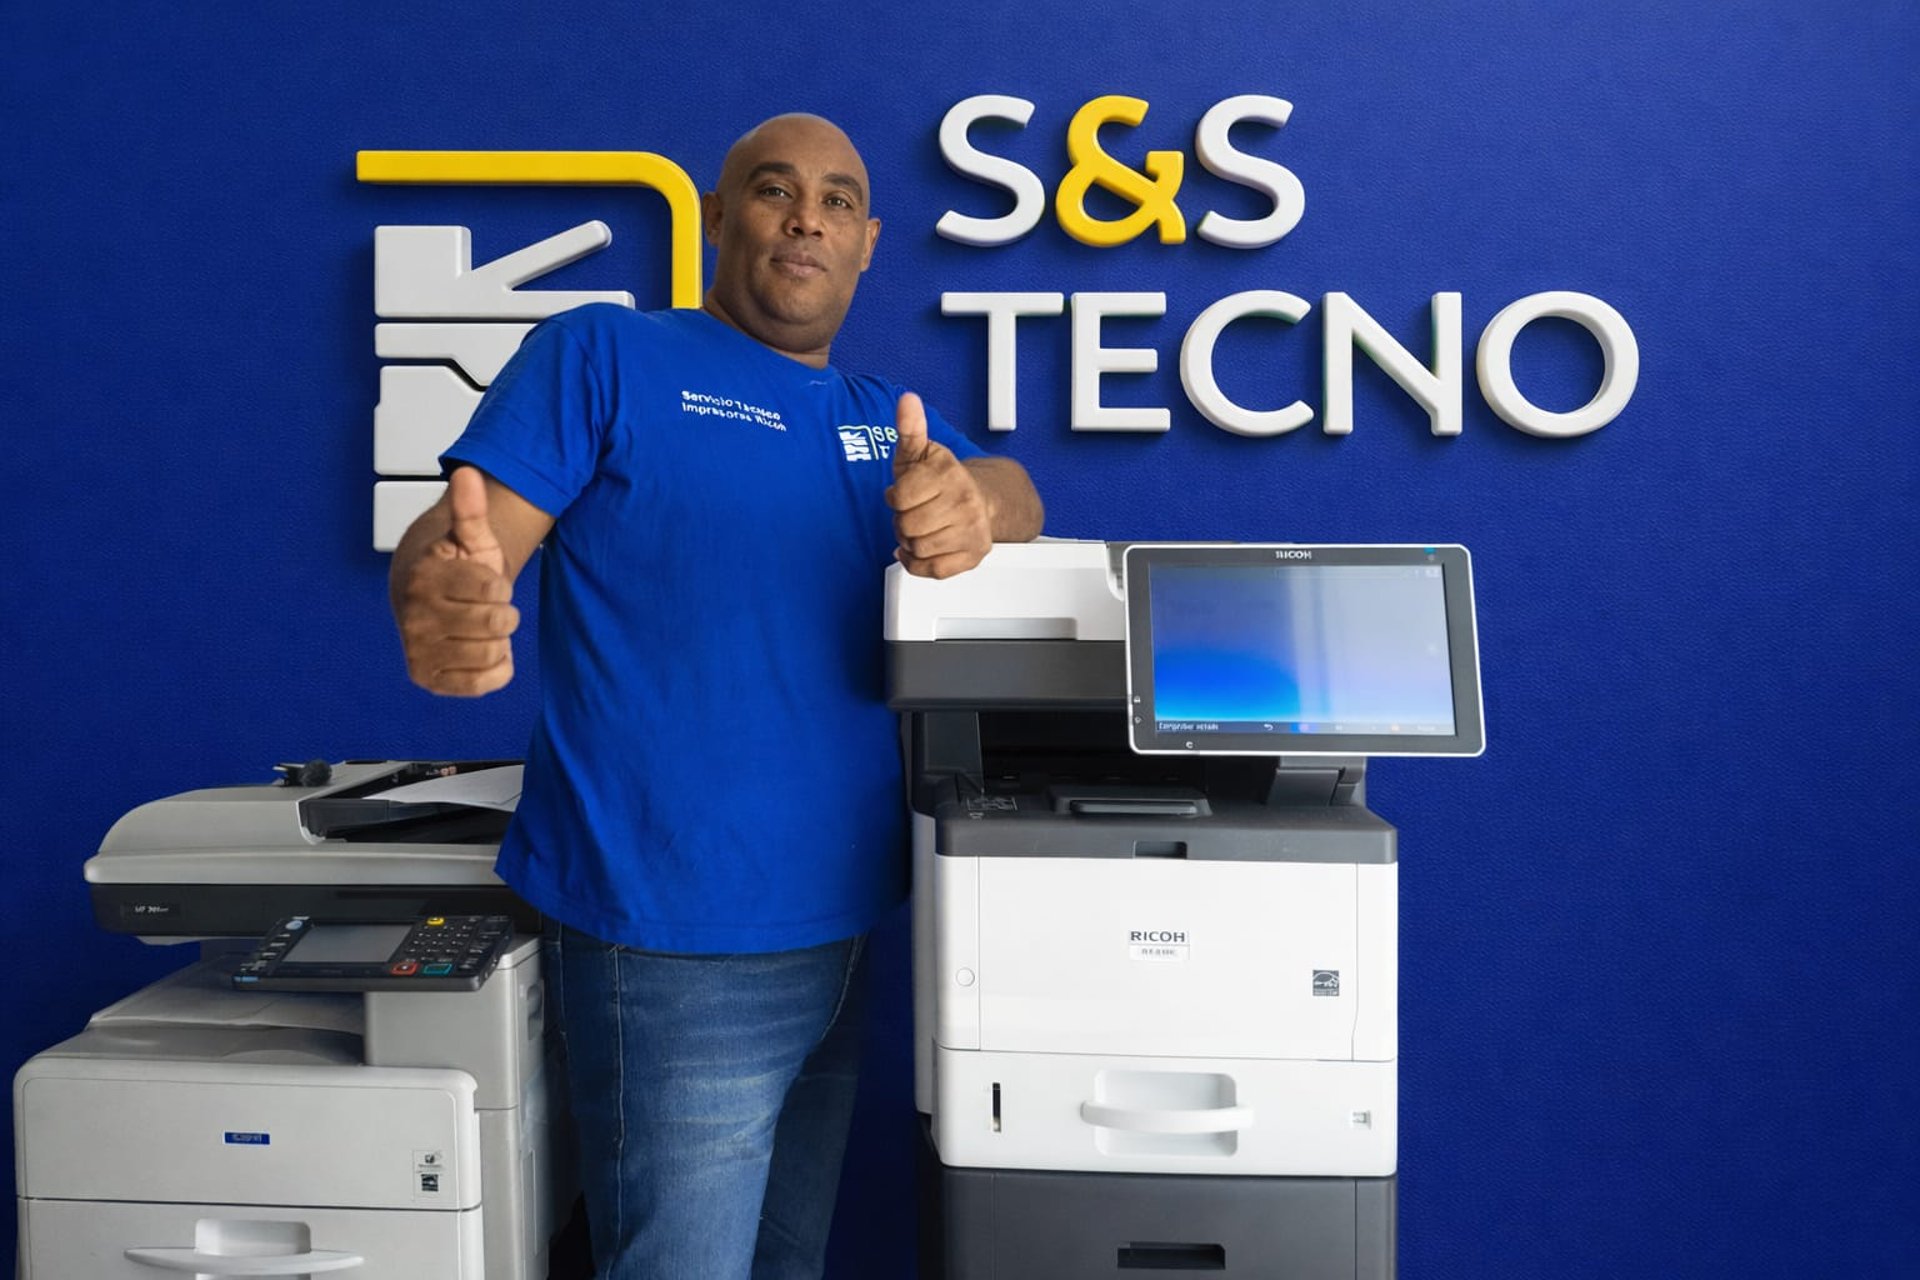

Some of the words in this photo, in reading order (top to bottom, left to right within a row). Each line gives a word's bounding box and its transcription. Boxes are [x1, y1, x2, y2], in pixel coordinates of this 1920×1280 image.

[936, 94, 1306, 248] S&S
[941, 290, 1640, 438] TECNO
[681, 390, 733, 407] Servicio
[872, 426, 899, 443] S&
[1130, 930, 1185, 943] RICOH
